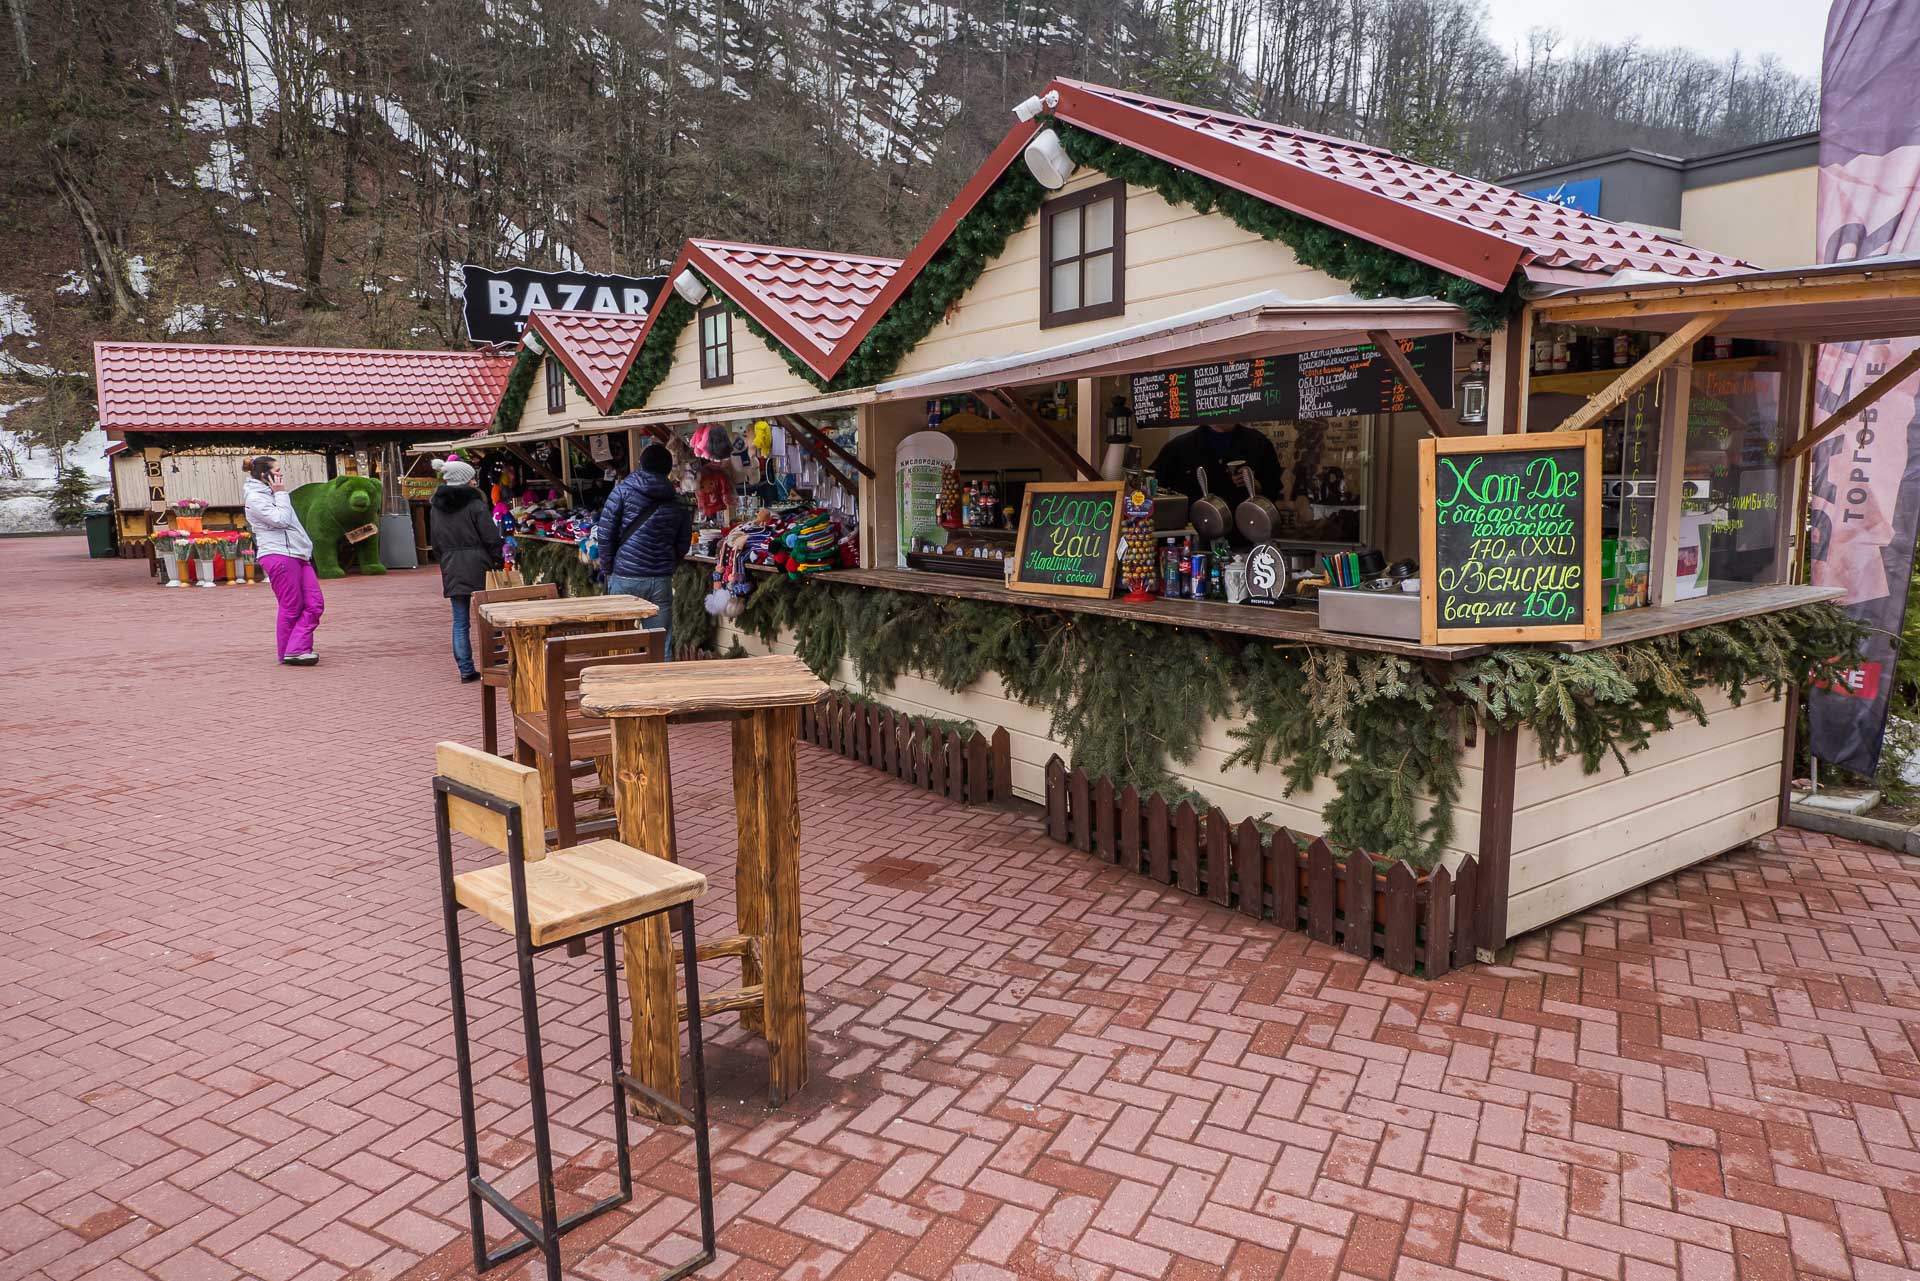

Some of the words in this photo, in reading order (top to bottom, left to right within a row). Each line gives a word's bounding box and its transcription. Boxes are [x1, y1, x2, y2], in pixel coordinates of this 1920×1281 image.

[488, 280, 650, 316] BAZAR
[1843, 362, 1886, 523] ТОРГОВЕ
[1436, 456, 1579, 508] Хот-Дог
[1032, 495, 1113, 537] Кофе
[1438, 508, 1449, 525] с
[1453, 501, 1565, 529] баварской
[1472, 518, 1575, 538] колбаской
[1050, 526, 1100, 558] Чай
[1439, 561, 1582, 595] Венские
[1444, 595, 1517, 625] вафли
